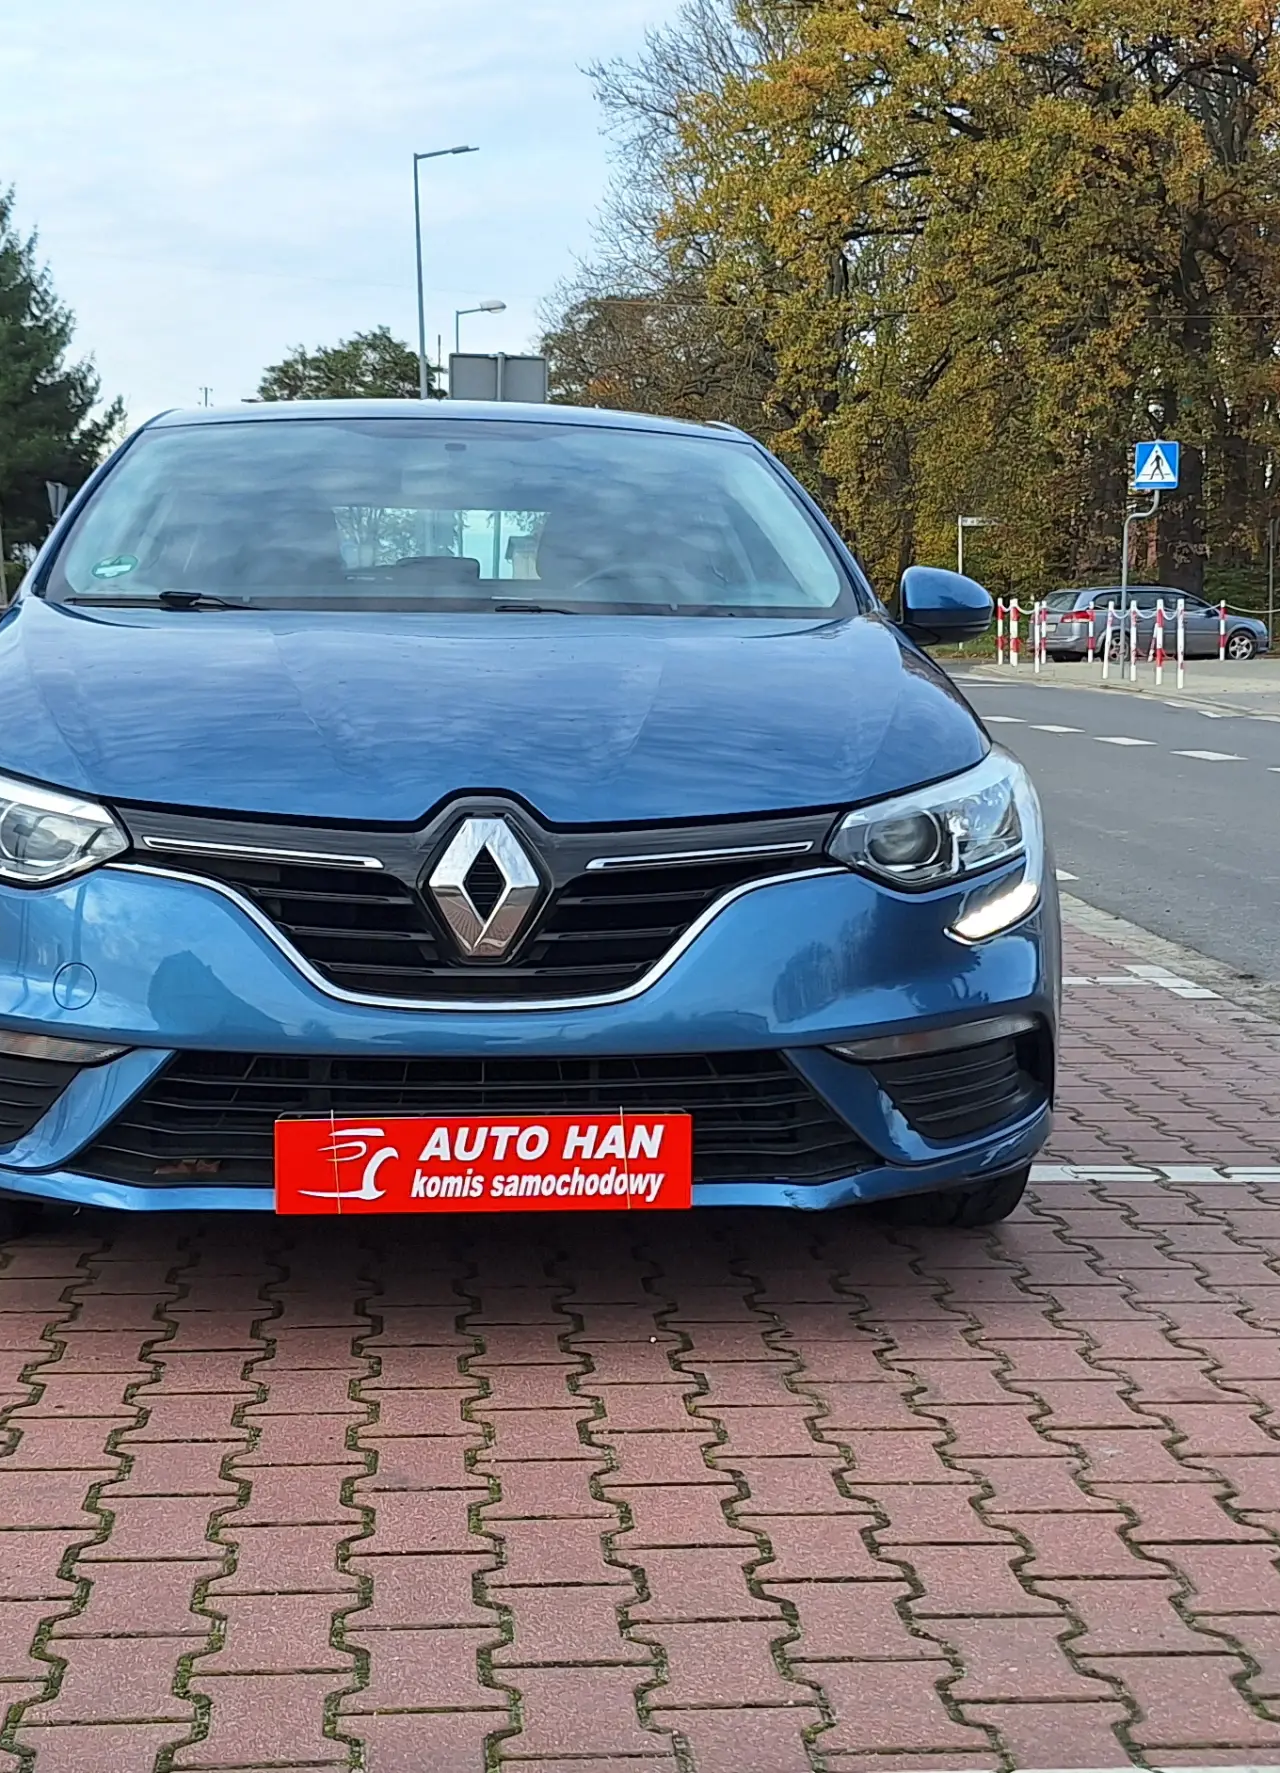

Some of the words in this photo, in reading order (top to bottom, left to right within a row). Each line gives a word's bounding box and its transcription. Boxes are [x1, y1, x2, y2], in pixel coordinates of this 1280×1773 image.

[419, 1125, 549, 1161] AUTO
[562, 1124, 665, 1160] HAN
[411, 1168, 484, 1198] komis
[490, 1166, 666, 1202] samochodowy
